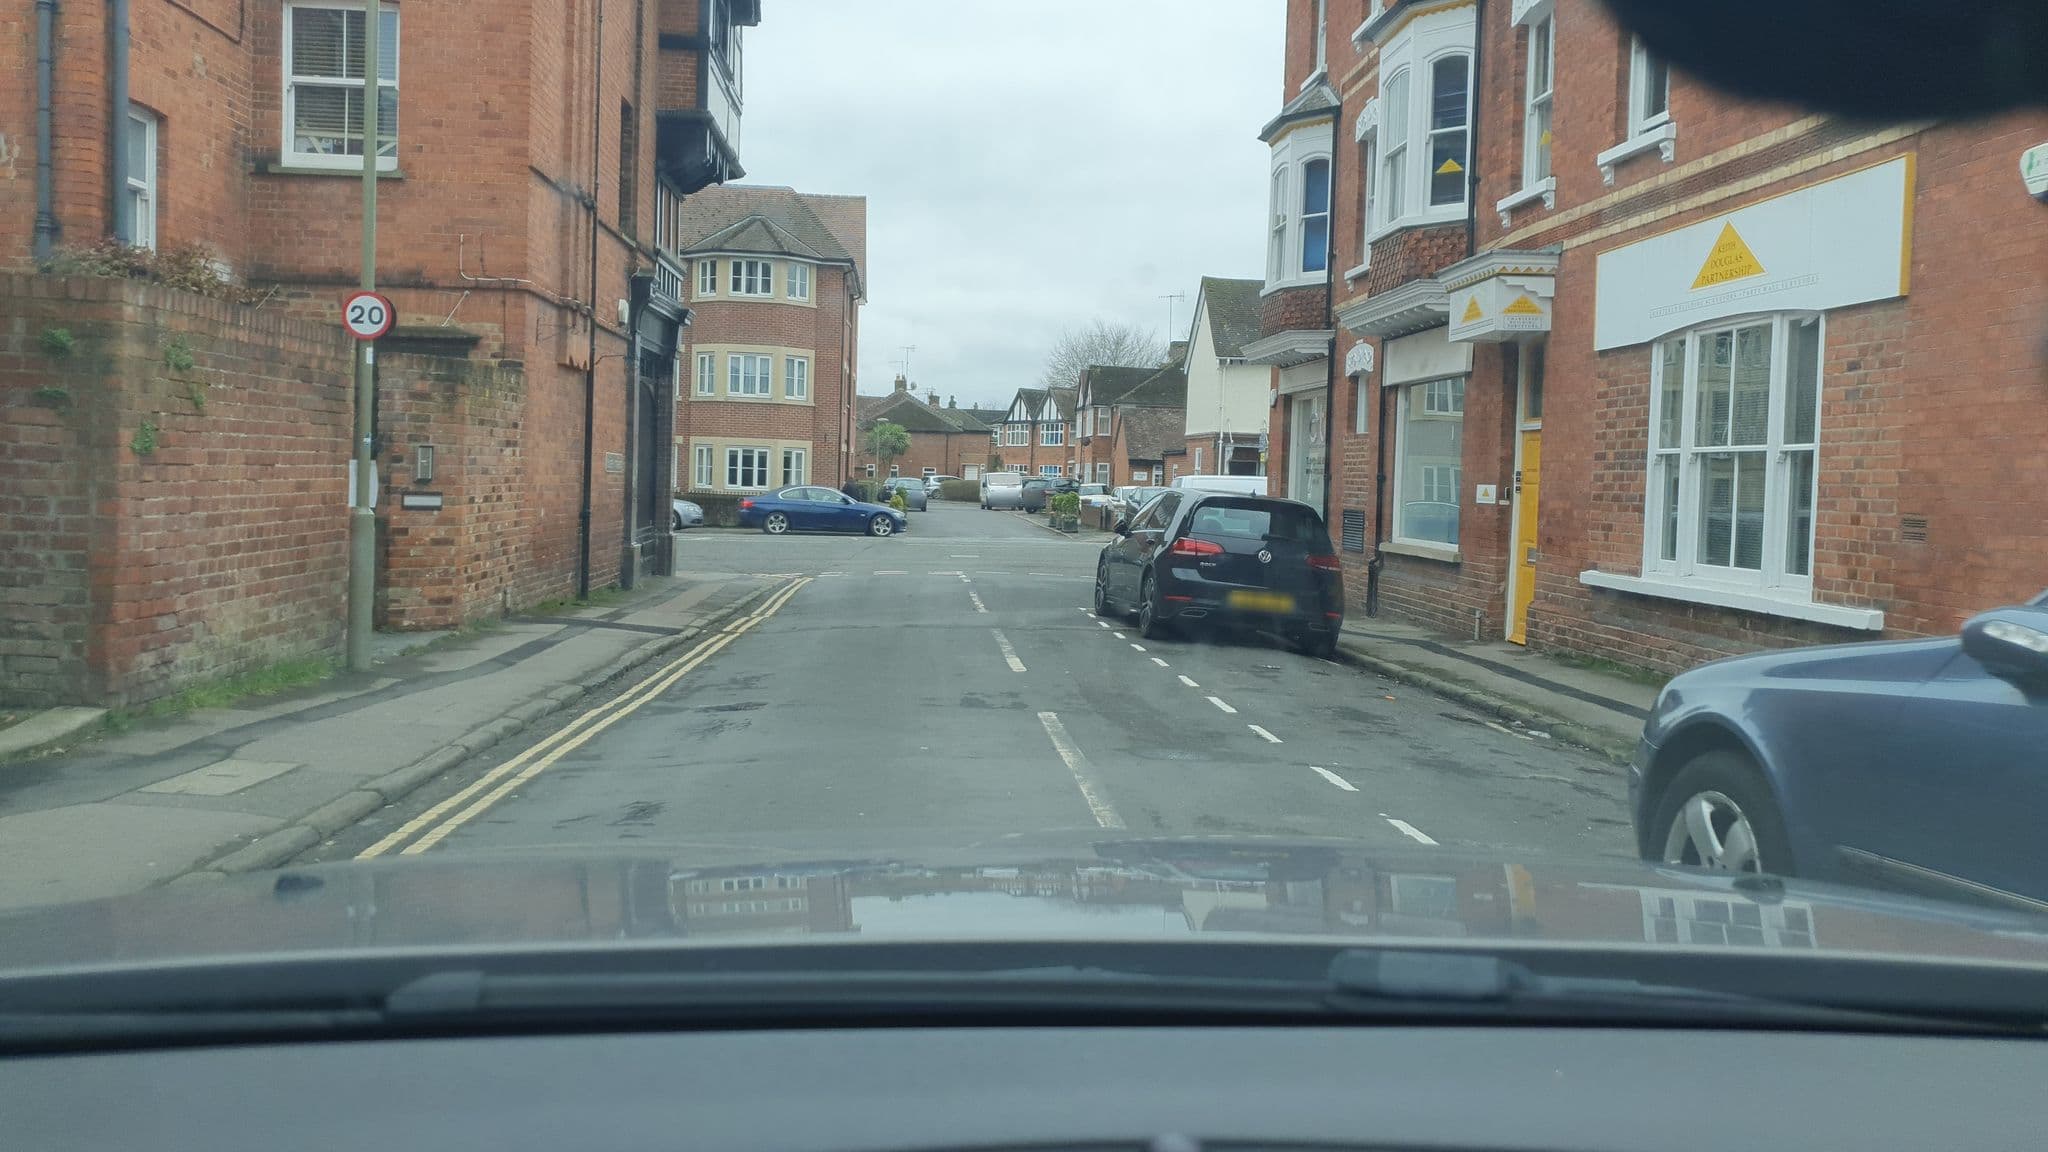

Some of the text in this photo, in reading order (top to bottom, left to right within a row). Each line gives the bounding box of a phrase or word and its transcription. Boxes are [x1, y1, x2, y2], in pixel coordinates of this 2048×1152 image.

[1710, 252, 1744, 269] DOUGLAS
[1701, 264, 1753, 284] PARTNERSHIP
[350, 305, 384, 325] 20
